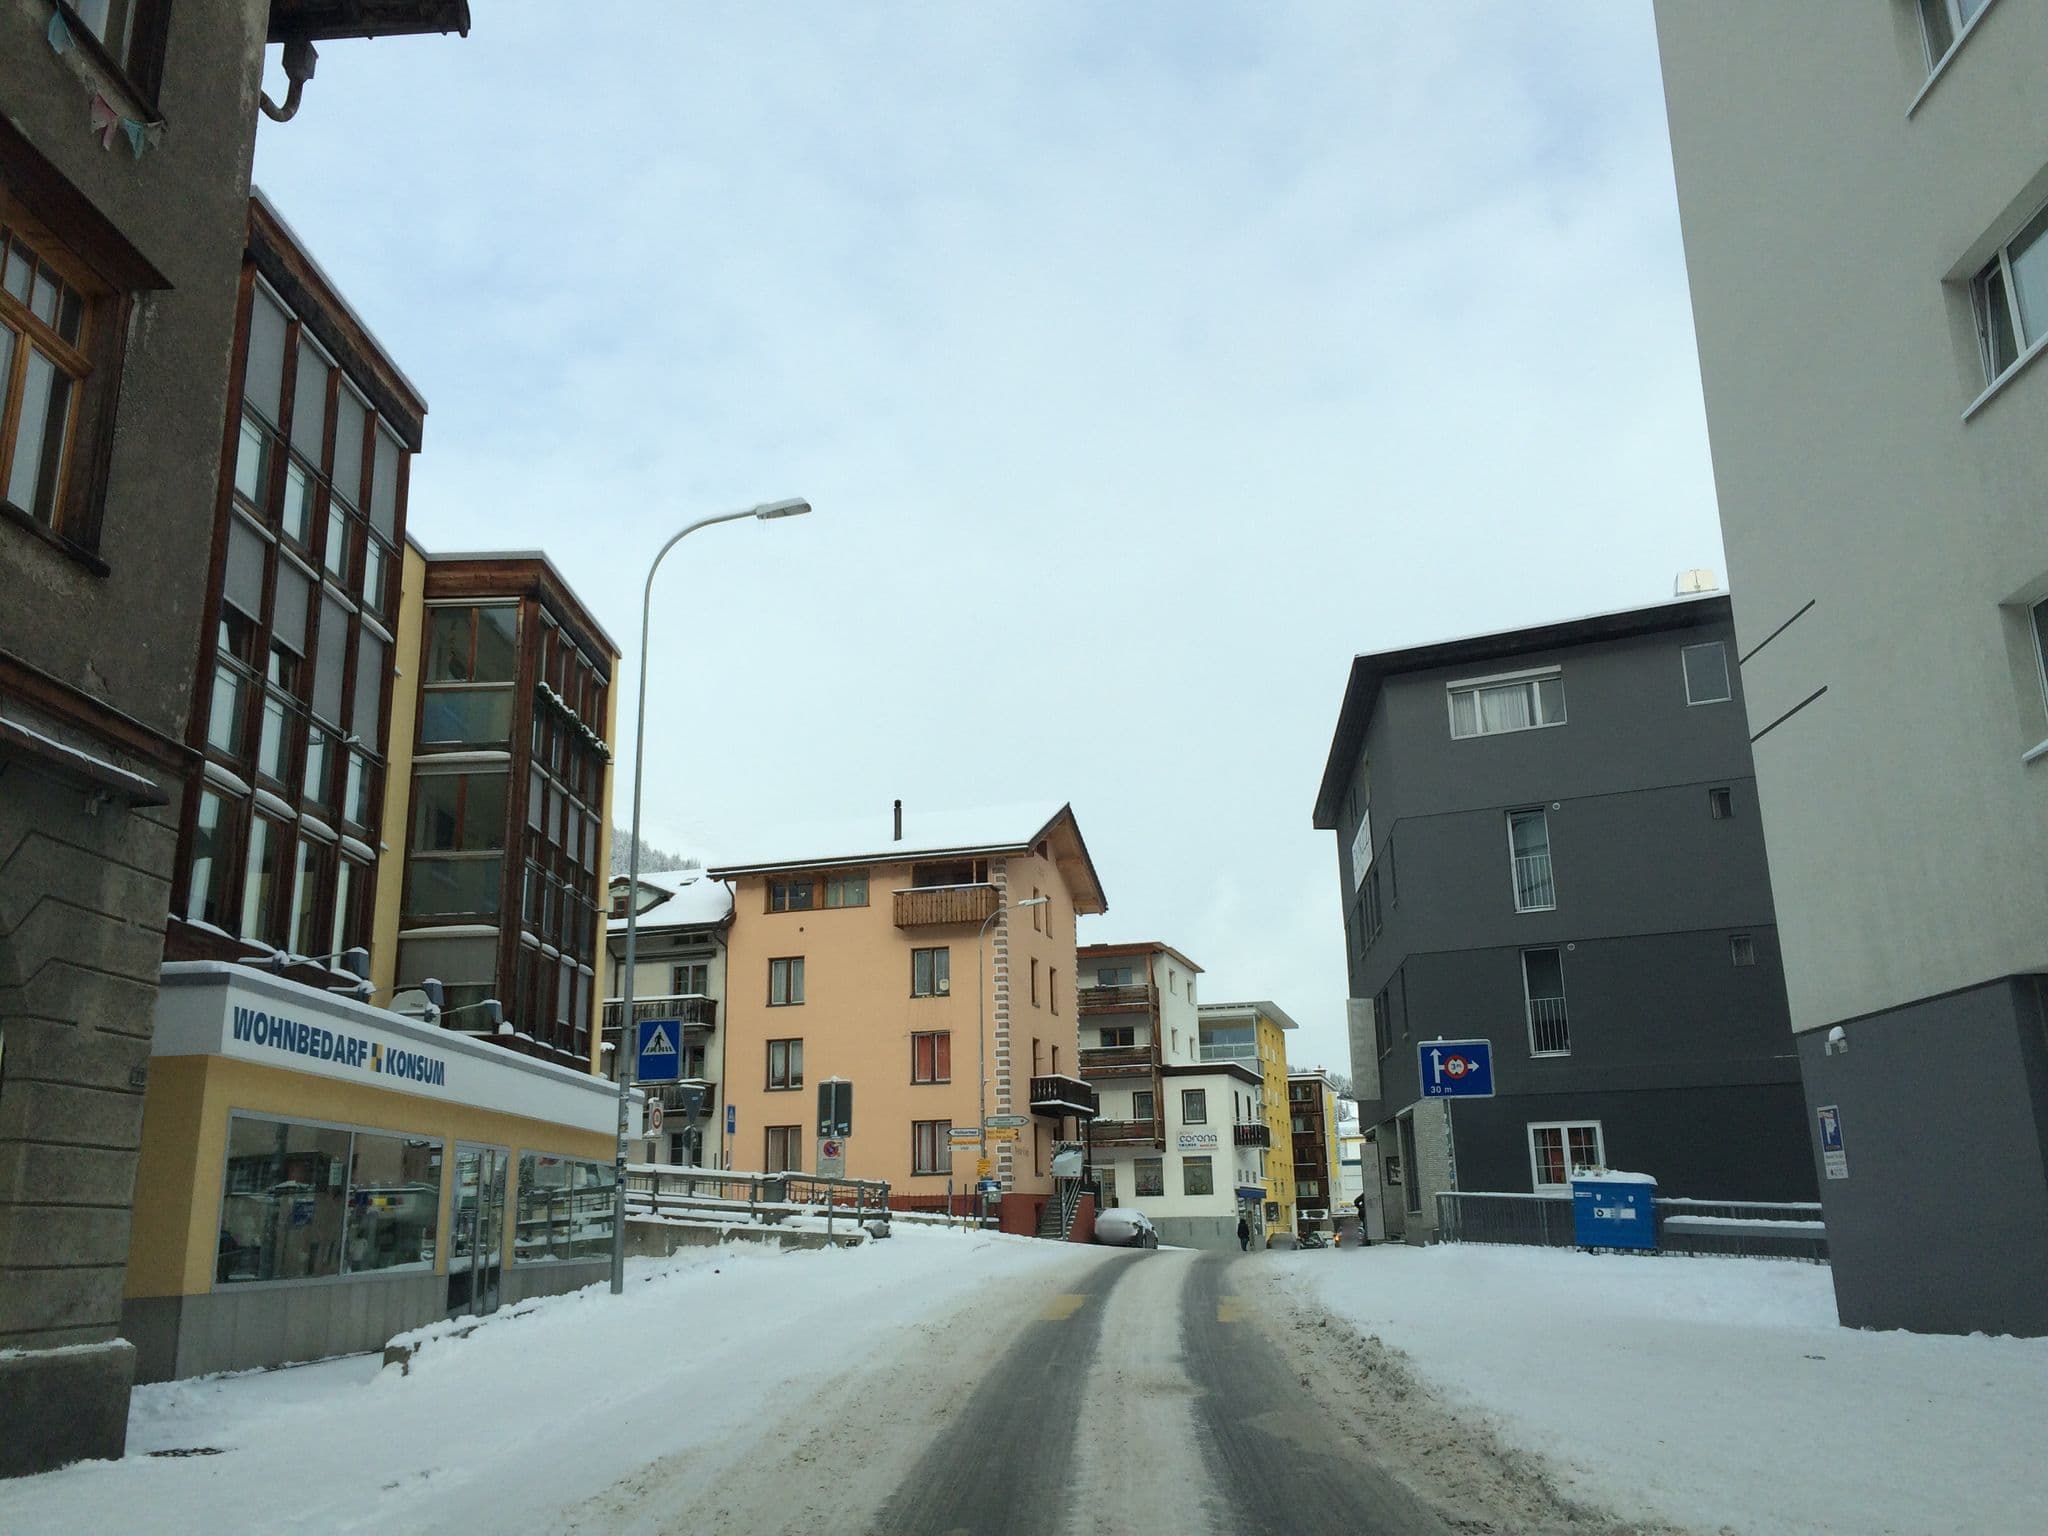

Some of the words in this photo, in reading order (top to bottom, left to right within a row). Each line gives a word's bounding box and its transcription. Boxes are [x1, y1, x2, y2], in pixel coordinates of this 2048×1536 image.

[233, 1006, 368, 1068] WOHNBEDARF
[386, 1048, 445, 1086] KONSUM
[1430, 1085, 1442, 1093] 30
[1179, 1134, 1218, 1143] corona
